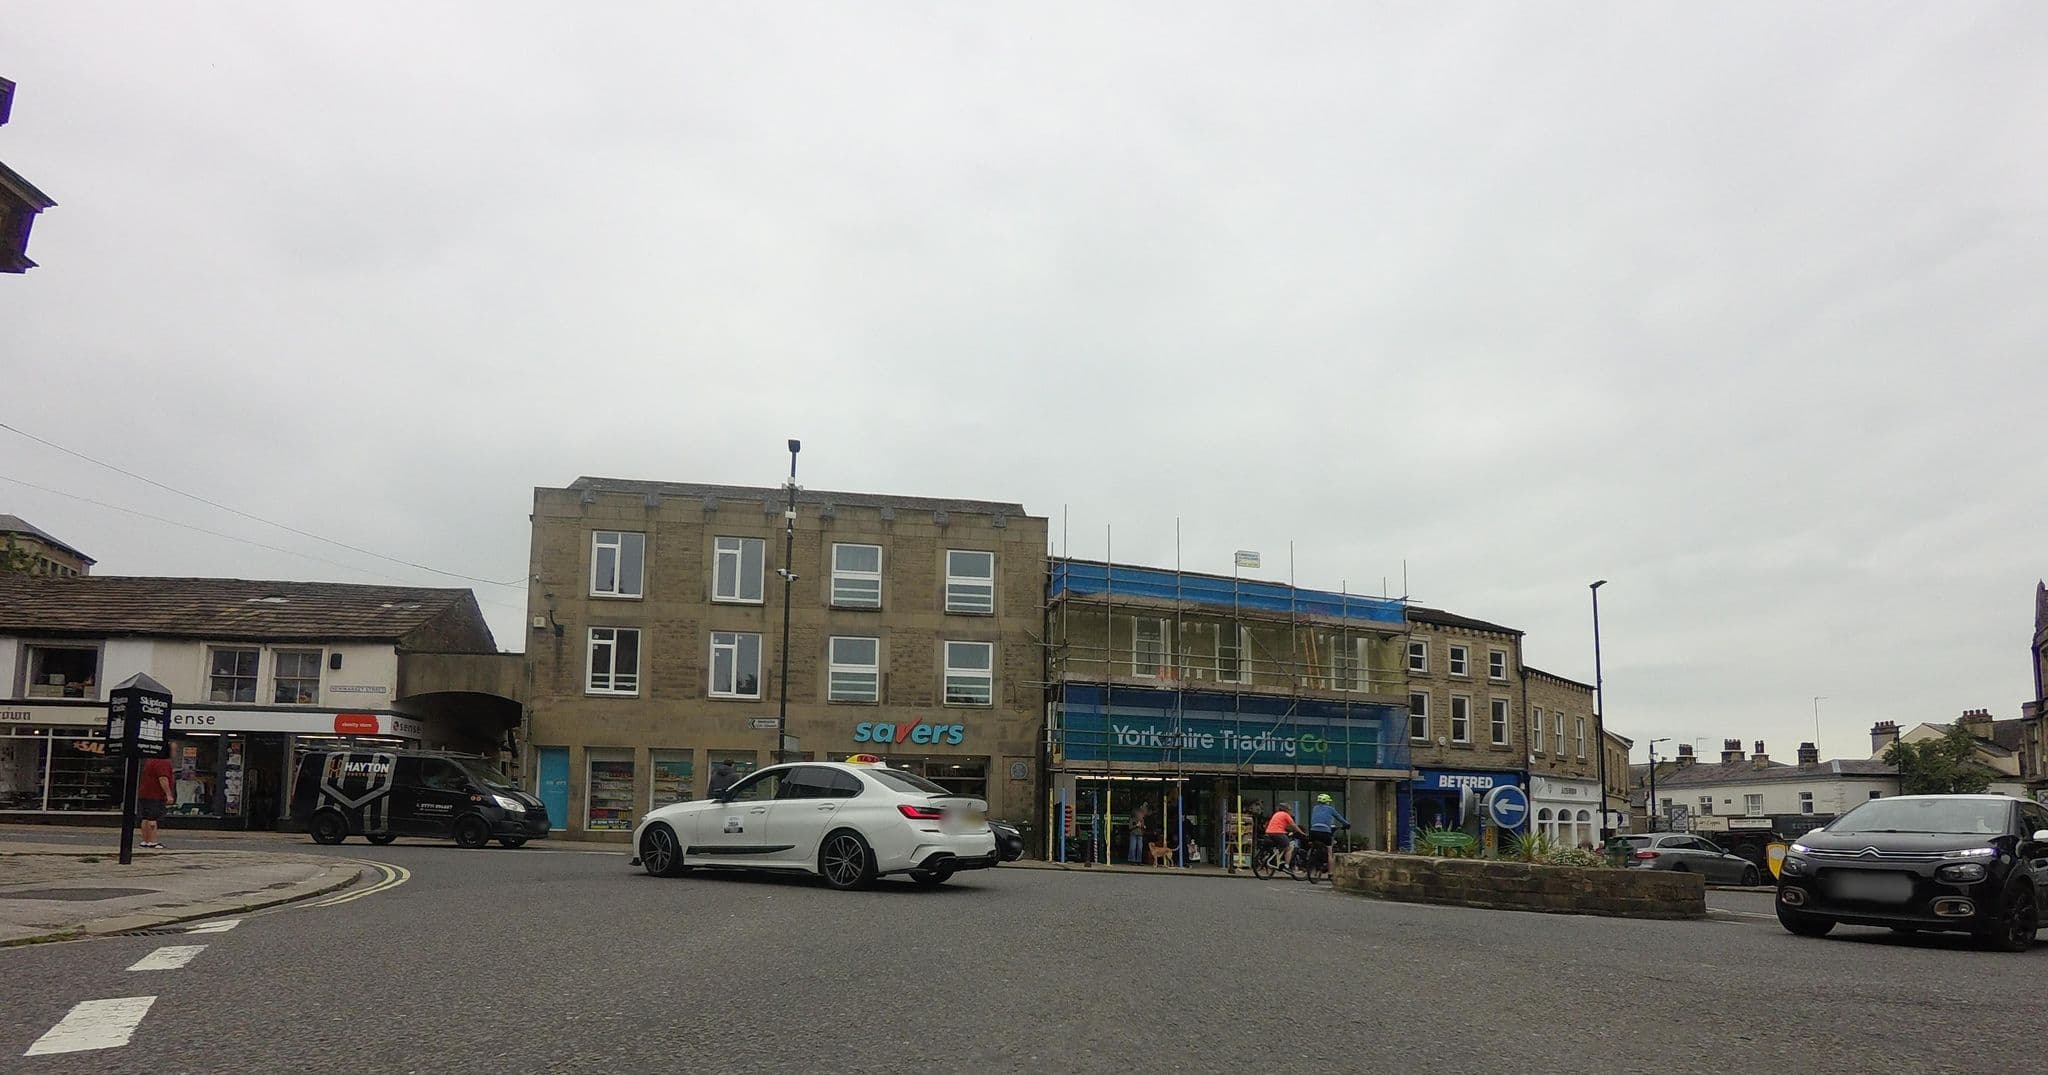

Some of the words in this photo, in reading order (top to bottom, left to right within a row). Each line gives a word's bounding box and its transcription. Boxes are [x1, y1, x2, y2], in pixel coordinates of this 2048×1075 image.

[140, 696, 168, 709] Skipton
[142, 704, 165, 715] Castle
[174, 715, 216, 725] ense
[854, 715, 964, 745] savers
[79, 741, 105, 754] SAL
[1220, 730, 1296, 757] Trading
[344, 762, 390, 773] HAYTON
